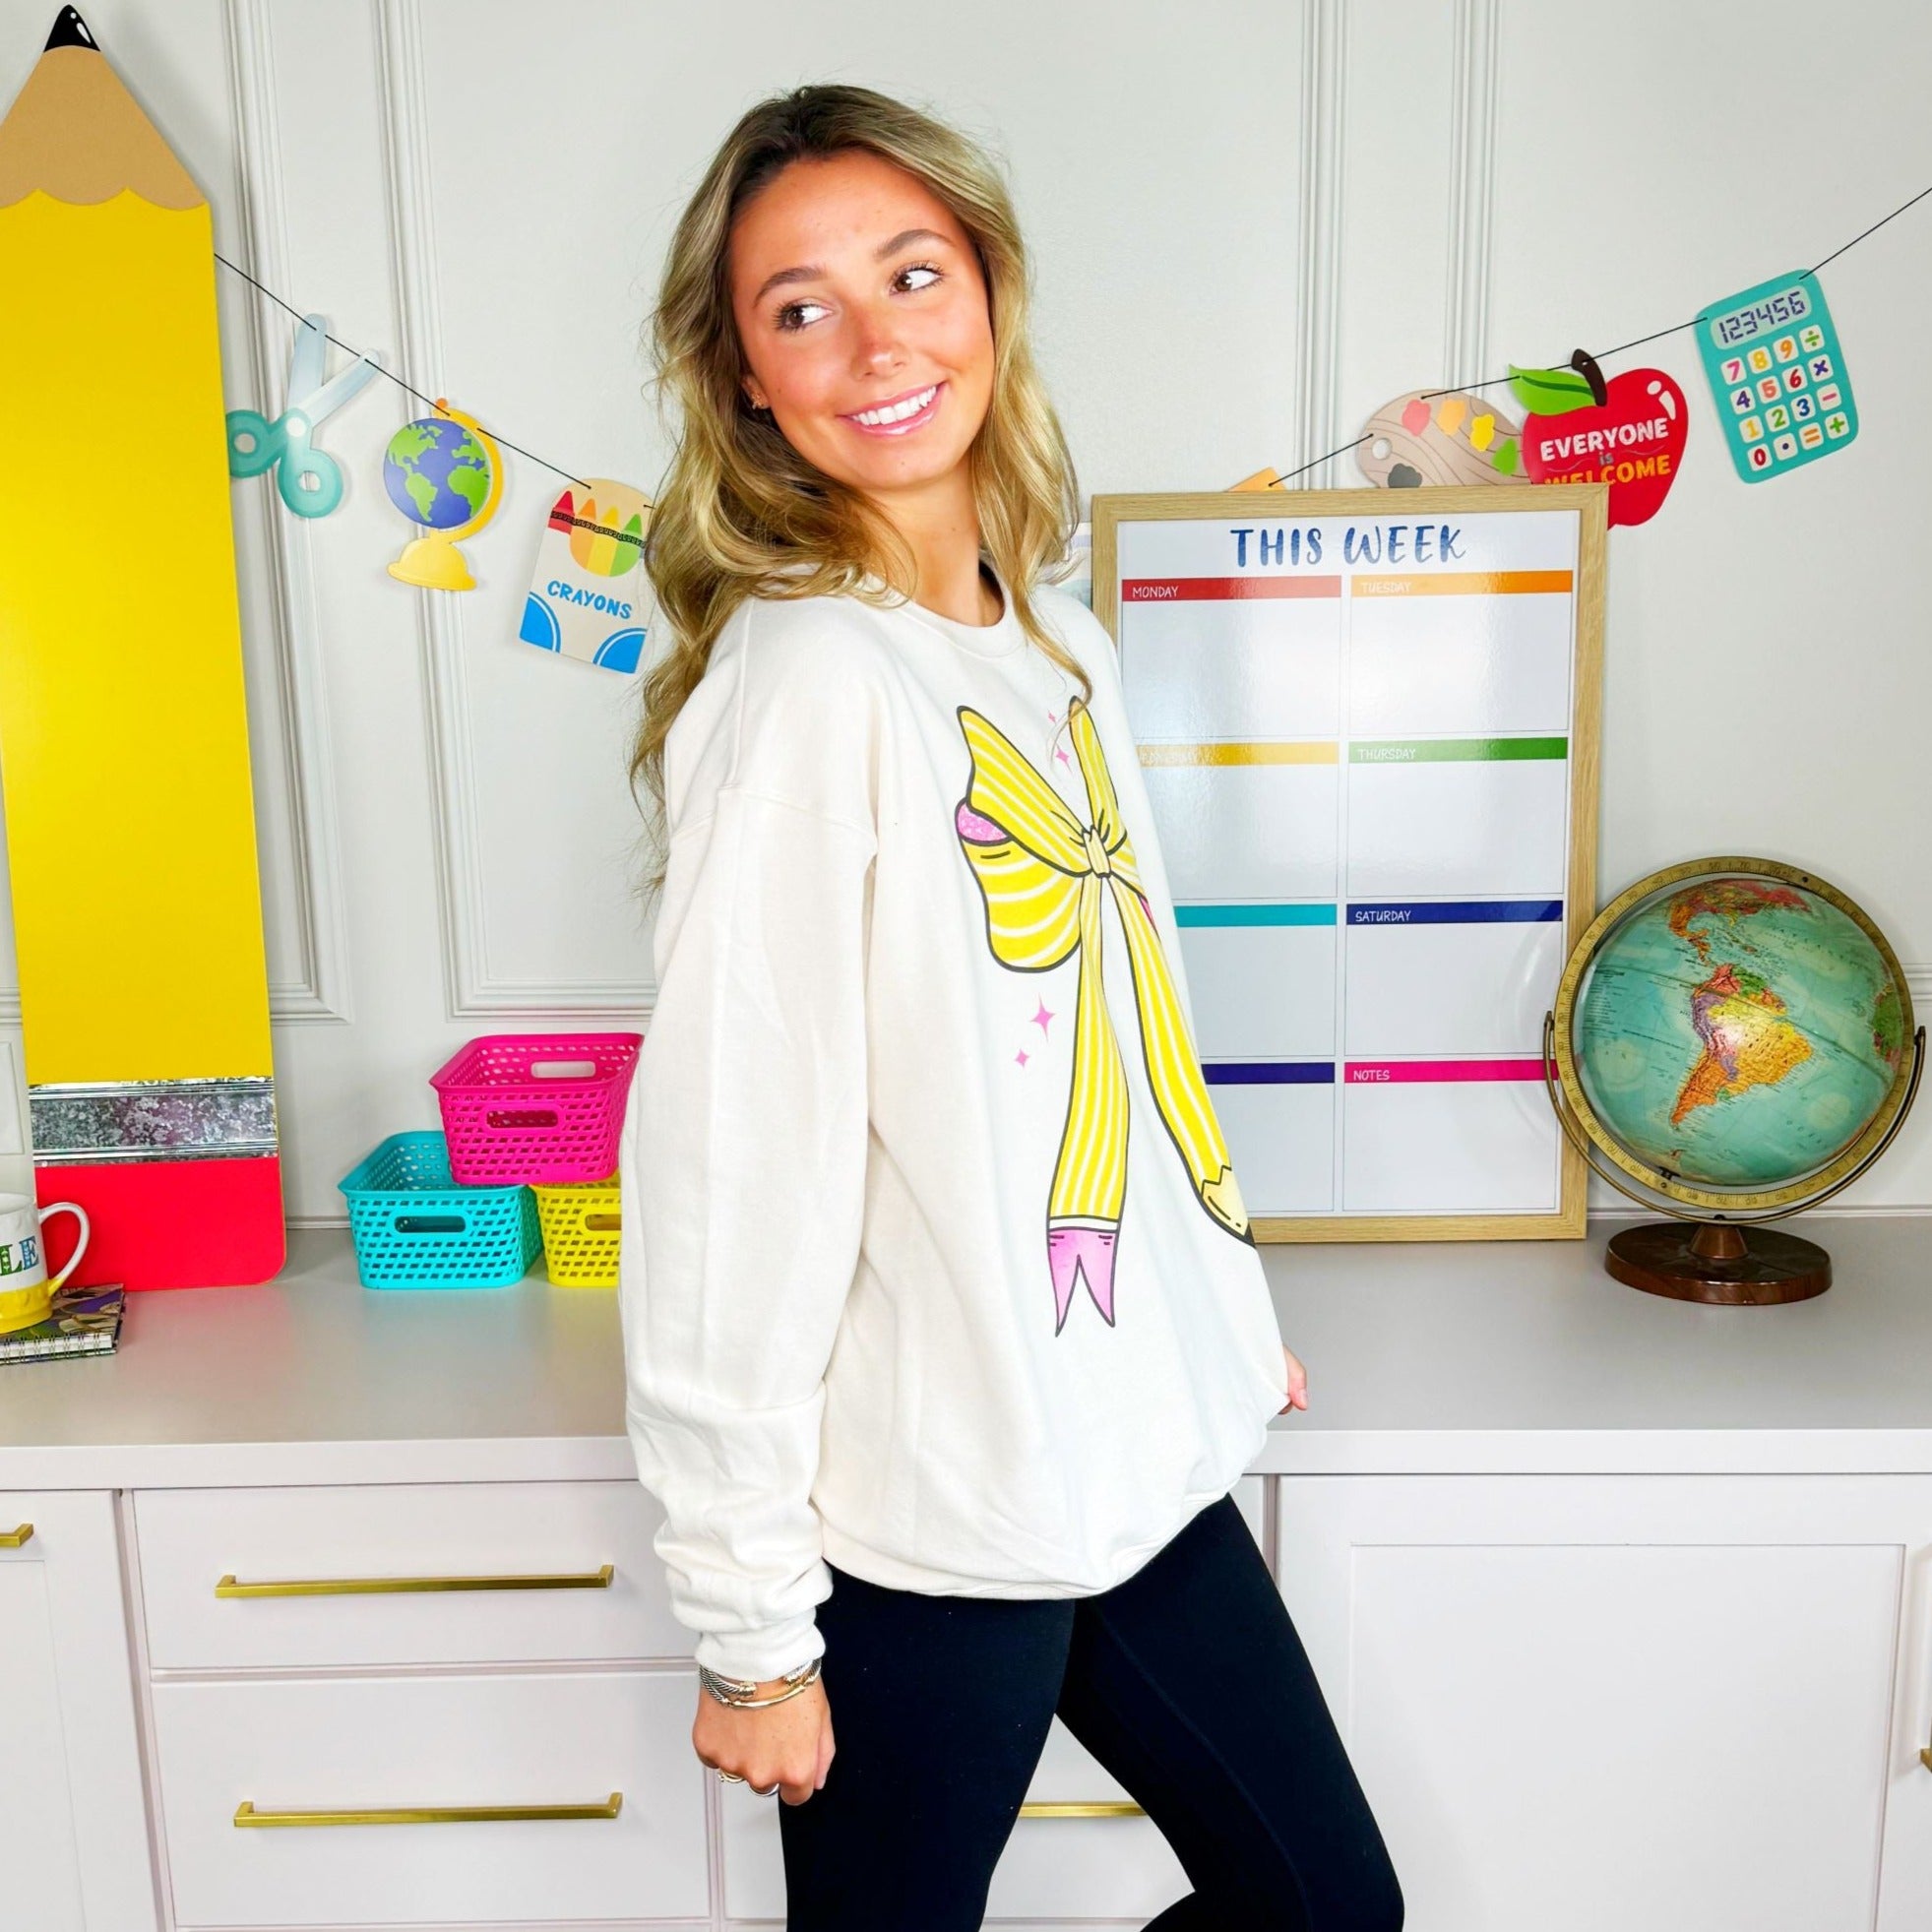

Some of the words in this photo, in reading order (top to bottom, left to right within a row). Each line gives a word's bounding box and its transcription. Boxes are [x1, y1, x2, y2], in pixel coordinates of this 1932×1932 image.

[1718, 290, 1806, 343] 123456
[1726, 360, 1740, 382] 7
[1752, 350, 1769, 370] 8
[1779, 340, 1792, 359] 9
[1736, 390, 1751, 408] 4
[1761, 380, 1776, 399] 5
[1789, 368, 1802, 389] 6
[1745, 419, 1760, 439] 1
[1772, 408, 1785, 428] 2
[1796, 398, 1810, 416] 3
[1540, 417, 1669, 462] EVERYONE
[1544, 455, 1671, 485] ELCOME
[1598, 451, 1614, 467] is
[1754, 448, 1767, 467] 0
[1229, 528, 1323, 568] THIS
[1342, 525, 1466, 565] WEEK
[547, 580, 633, 620] CRAYONS
[1132, 585, 1179, 598] MONDAY
[1359, 581, 1412, 594] TUESDAY
[1357, 748, 1416, 761] THURSDAY
[1354, 909, 1411, 922] SATURDAY
[1352, 1069, 1390, 1082] NOTES
